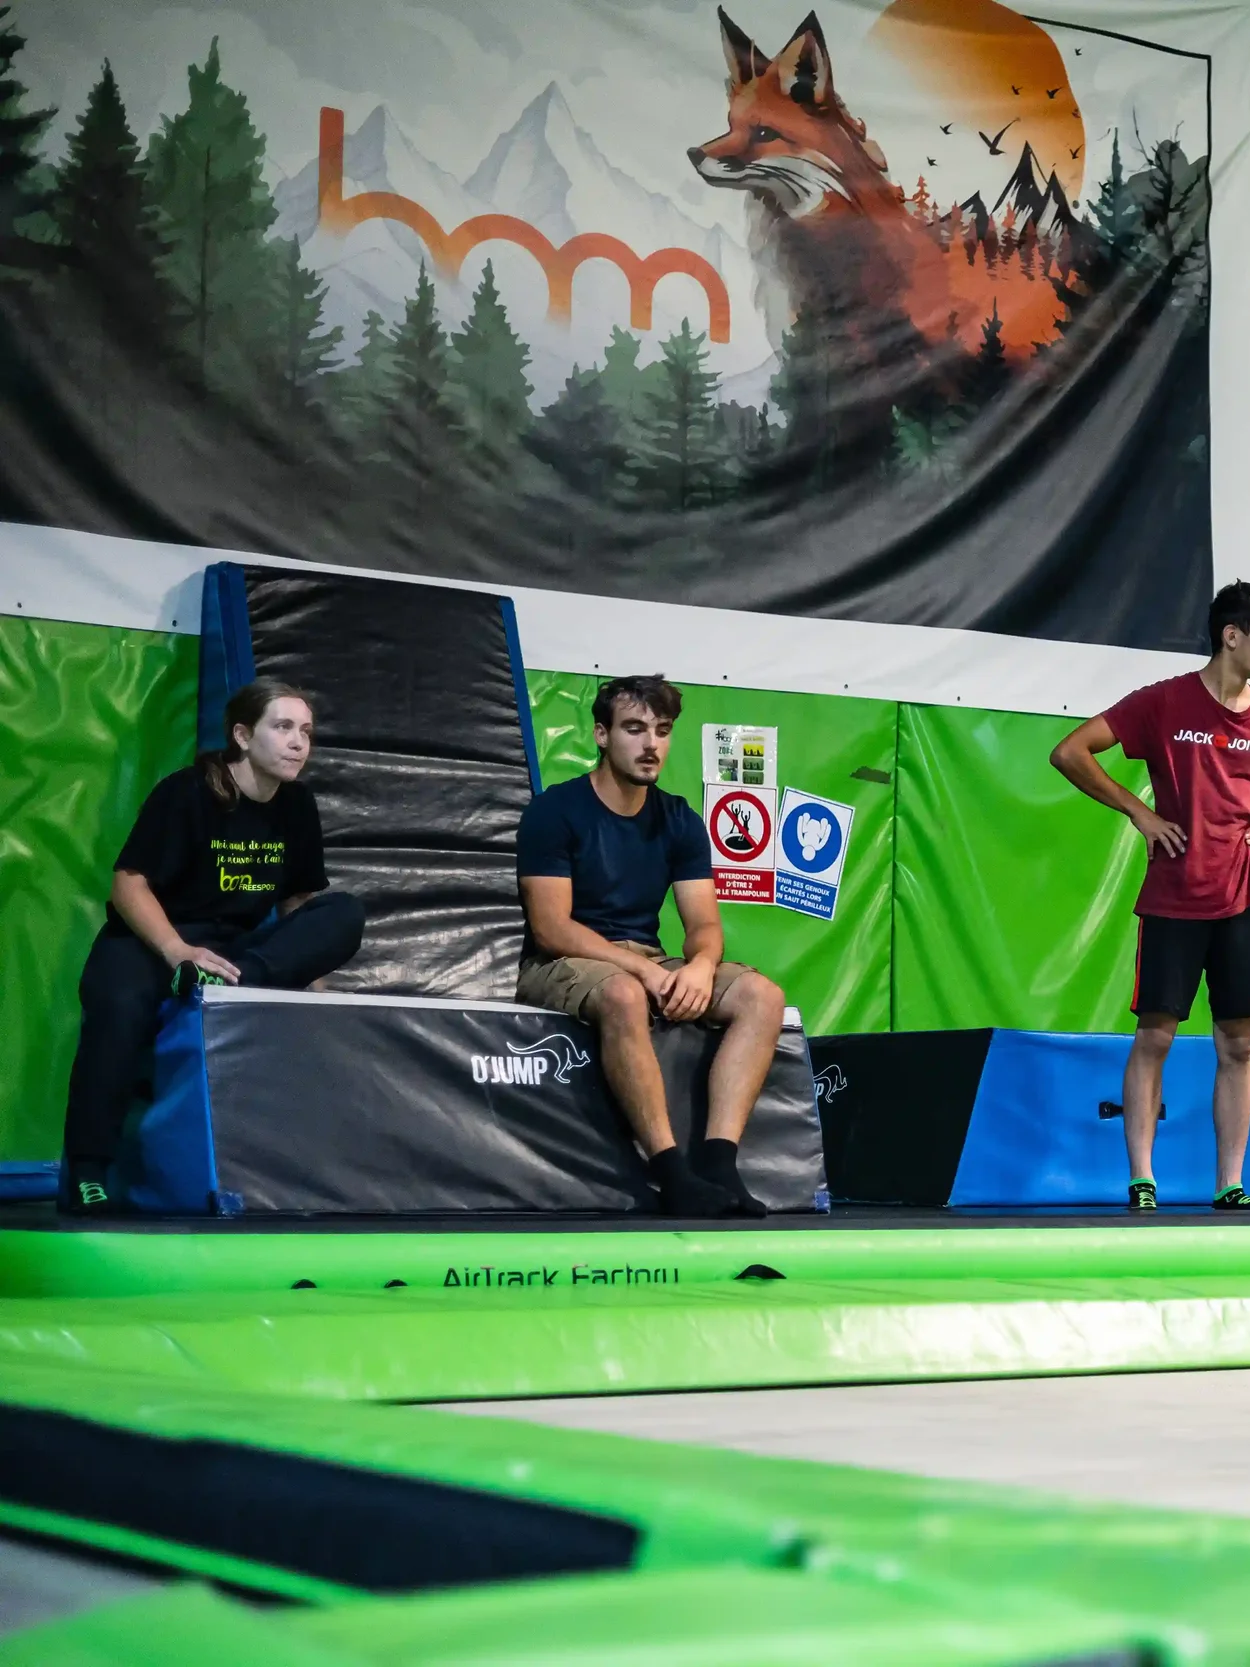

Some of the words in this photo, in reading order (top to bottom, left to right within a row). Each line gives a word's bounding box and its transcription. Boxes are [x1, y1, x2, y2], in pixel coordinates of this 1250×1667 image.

[1174, 729, 1213, 745] JACK
[718, 872, 761, 882] INTERDICTION
[731, 889, 770, 898] TRAMPOLINE
[780, 884, 805, 897] ÉCARTÉS
[806, 892, 822, 902] LORS
[793, 880, 804, 889] SES
[804, 884, 830, 897] GENOUX
[784, 894, 800, 904] SAUT
[800, 899, 831, 913] PÉRILLEUX
[443, 1266, 559, 1287] AirTrack
